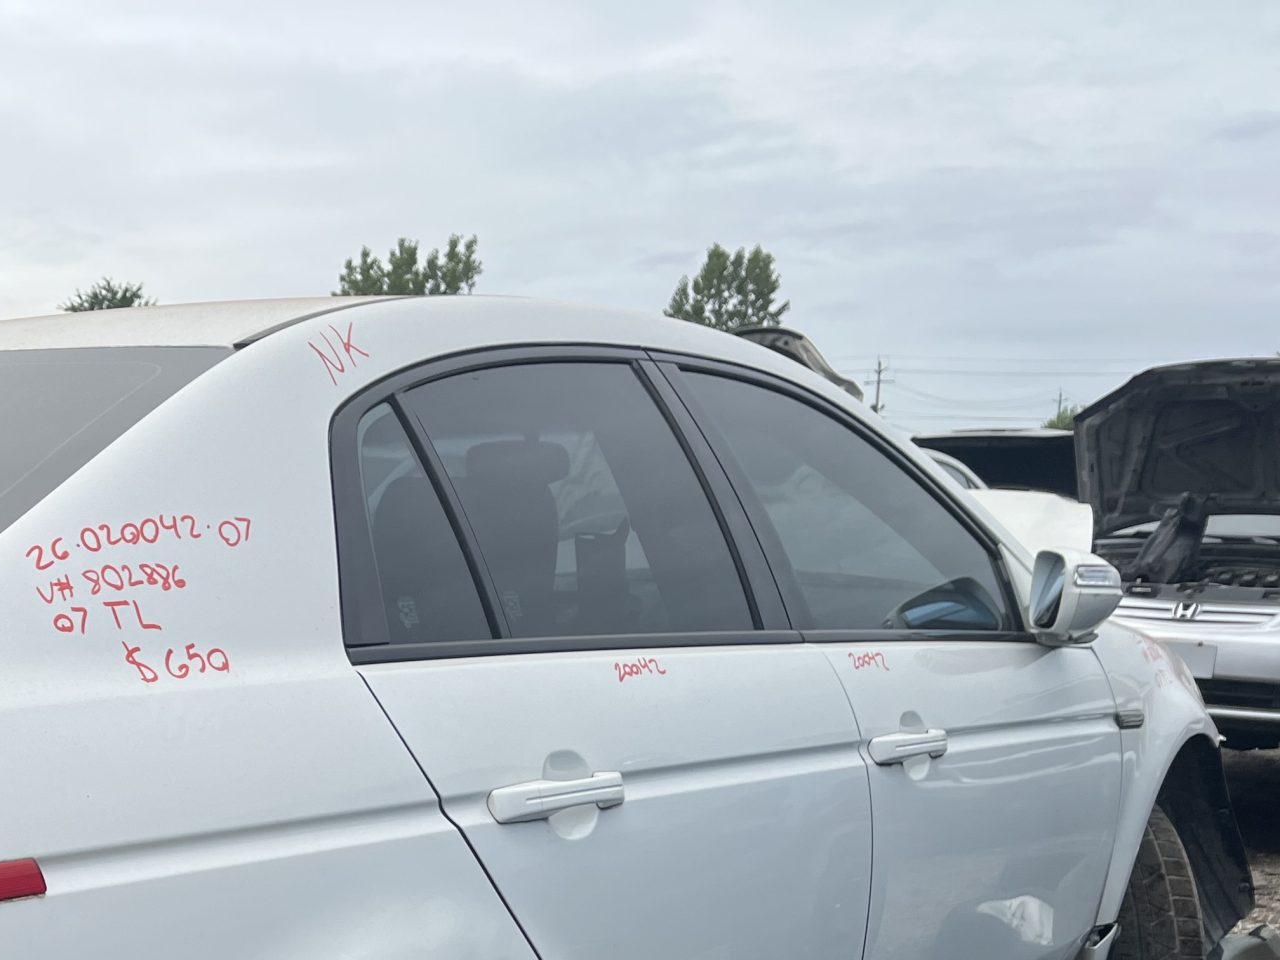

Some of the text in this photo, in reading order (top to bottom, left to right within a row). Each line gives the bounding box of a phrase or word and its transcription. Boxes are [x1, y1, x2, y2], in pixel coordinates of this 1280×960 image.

[307, 321, 370, 386] NK
[81, 563, 187, 595] 802886
[102, 599, 162, 631] TL
